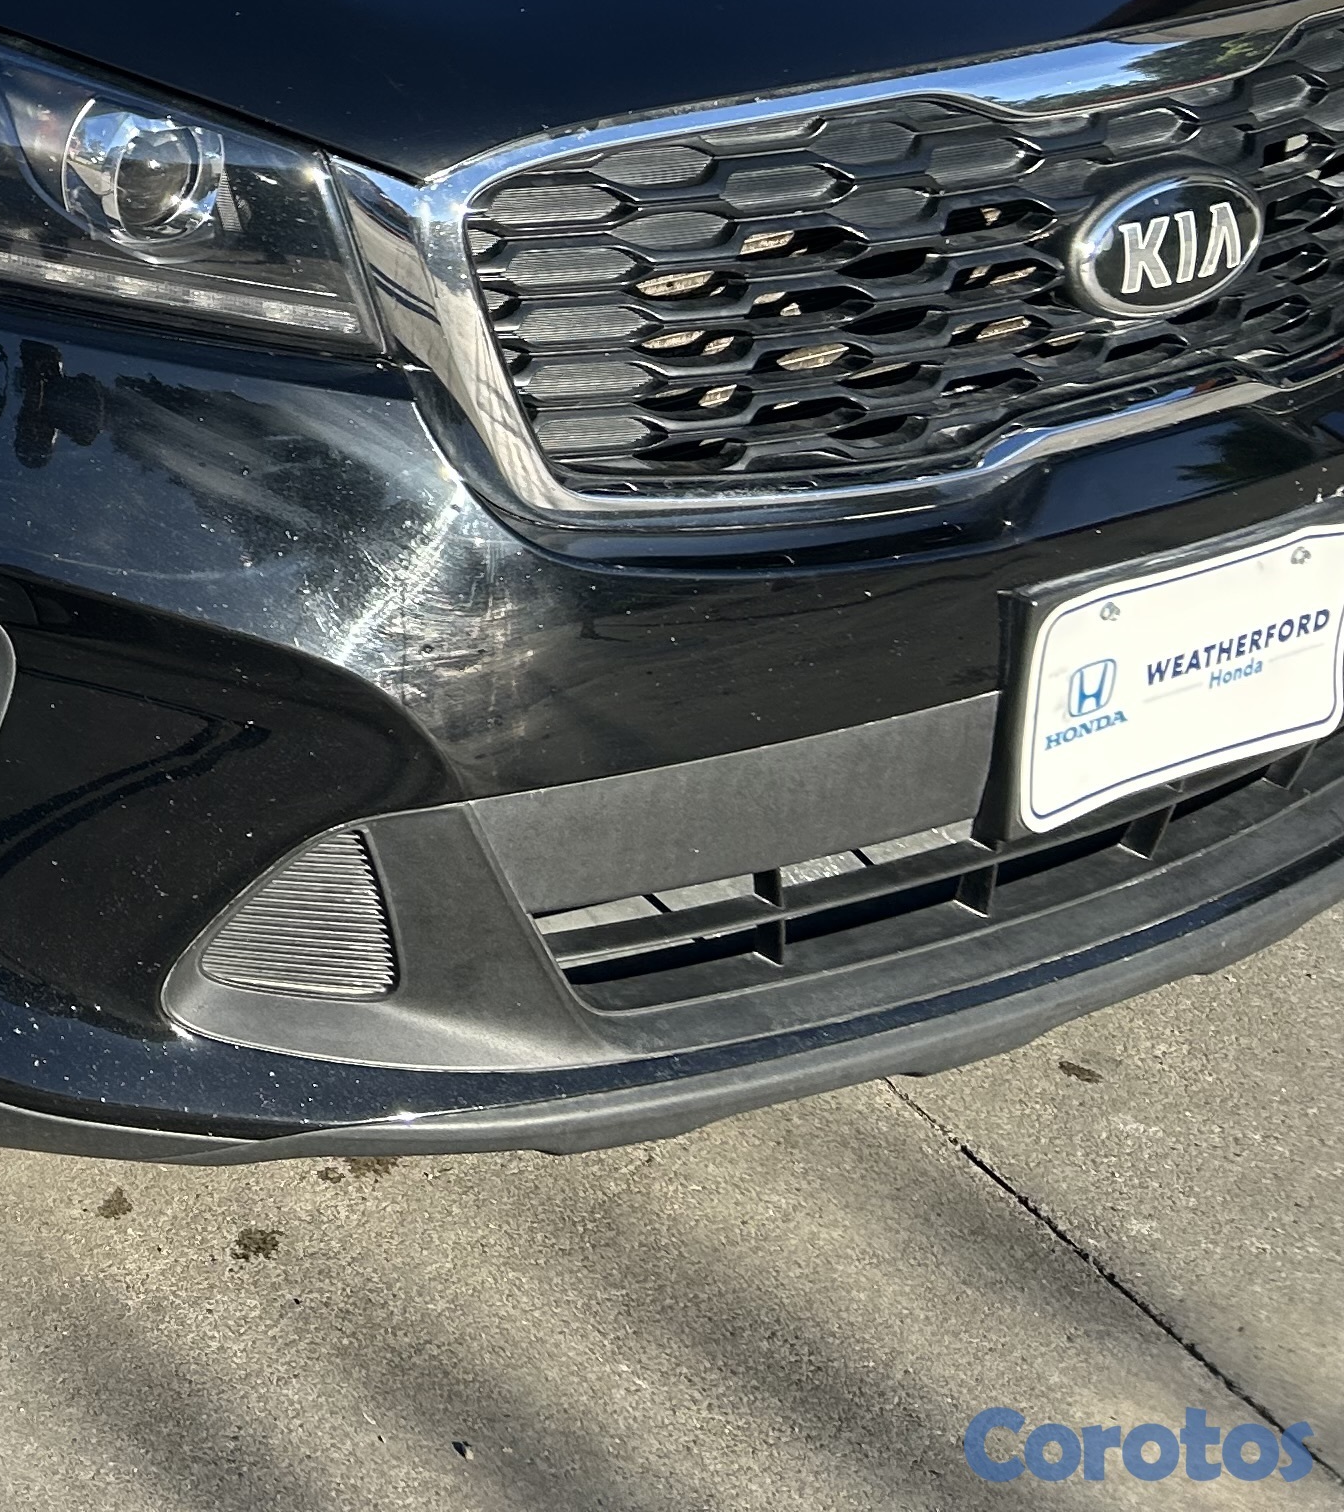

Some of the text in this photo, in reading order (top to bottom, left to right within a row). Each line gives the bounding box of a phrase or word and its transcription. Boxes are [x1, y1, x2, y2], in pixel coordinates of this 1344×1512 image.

[1118, 201, 1242, 294] KIA
[1146, 608, 1331, 686] WEATHERFORD
[1208, 658, 1264, 690] Honda
[1045, 709, 1129, 752] HONDA
